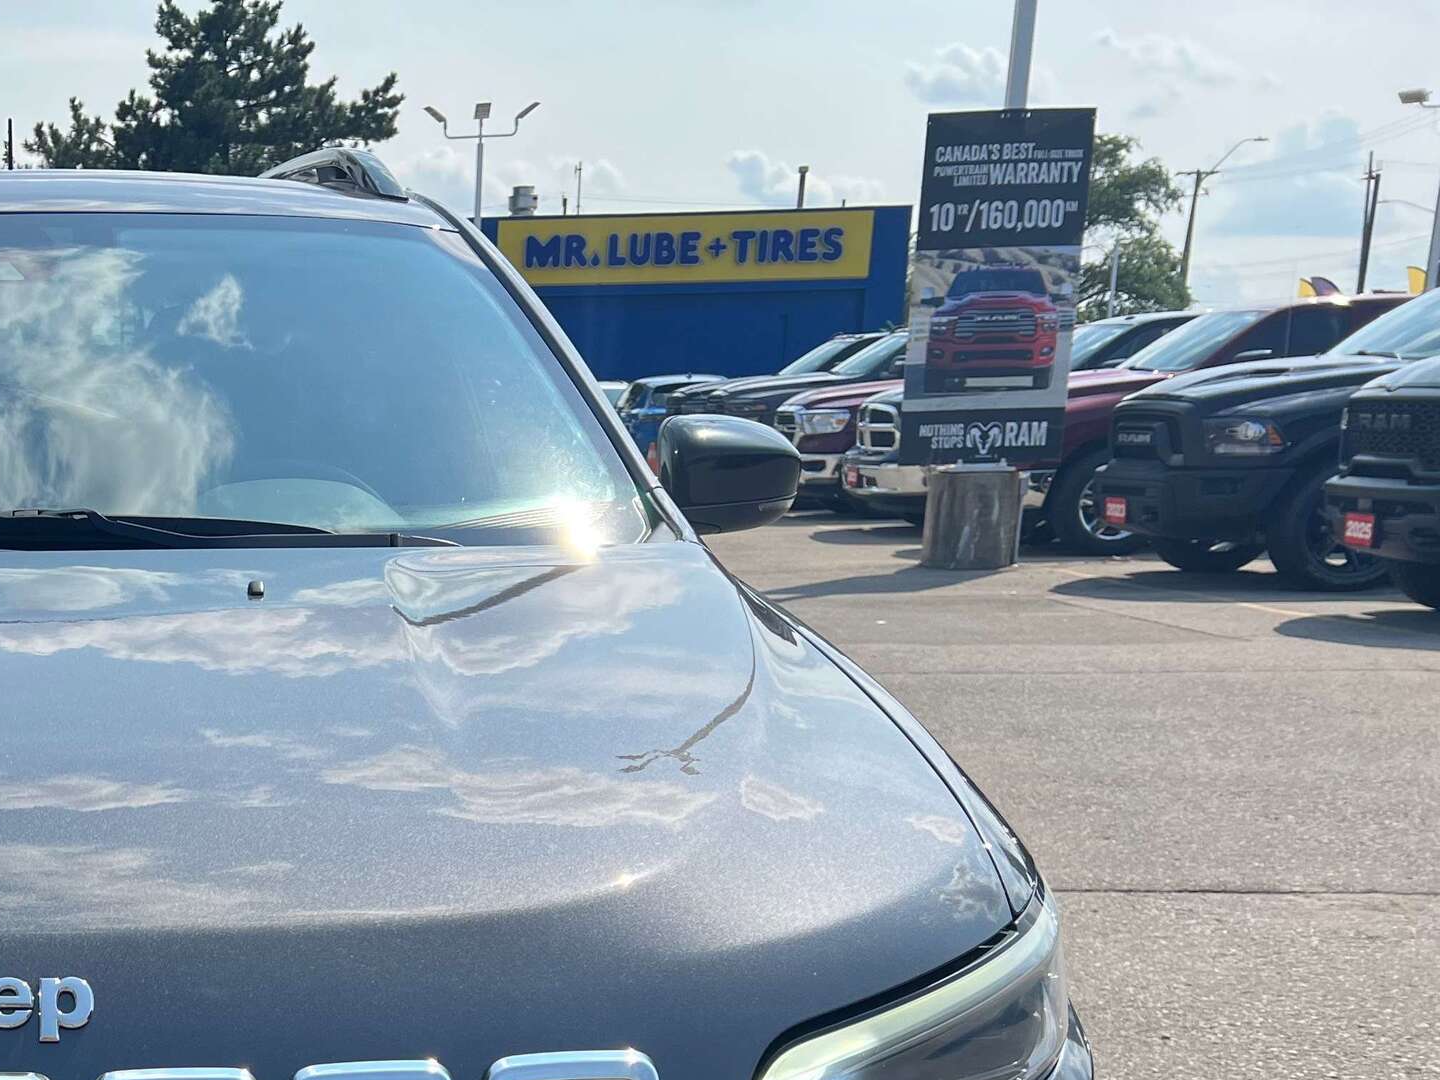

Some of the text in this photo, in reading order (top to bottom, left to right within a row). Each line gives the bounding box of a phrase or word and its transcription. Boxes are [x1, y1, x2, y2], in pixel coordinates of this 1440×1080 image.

[935, 144, 1001, 163] CANADA'S
[1002, 142, 1036, 160] BEST
[934, 161, 1082, 185] POWERTRAIN WARRANTY
[953, 174, 988, 187] LIMITED
[524, 233, 600, 269] MR.
[608, 231, 703, 267] LUBE
[731, 227, 845, 265] TIRES
[919, 421, 1048, 447] NOTHING RAM
[931, 436, 963, 449] STOPS
